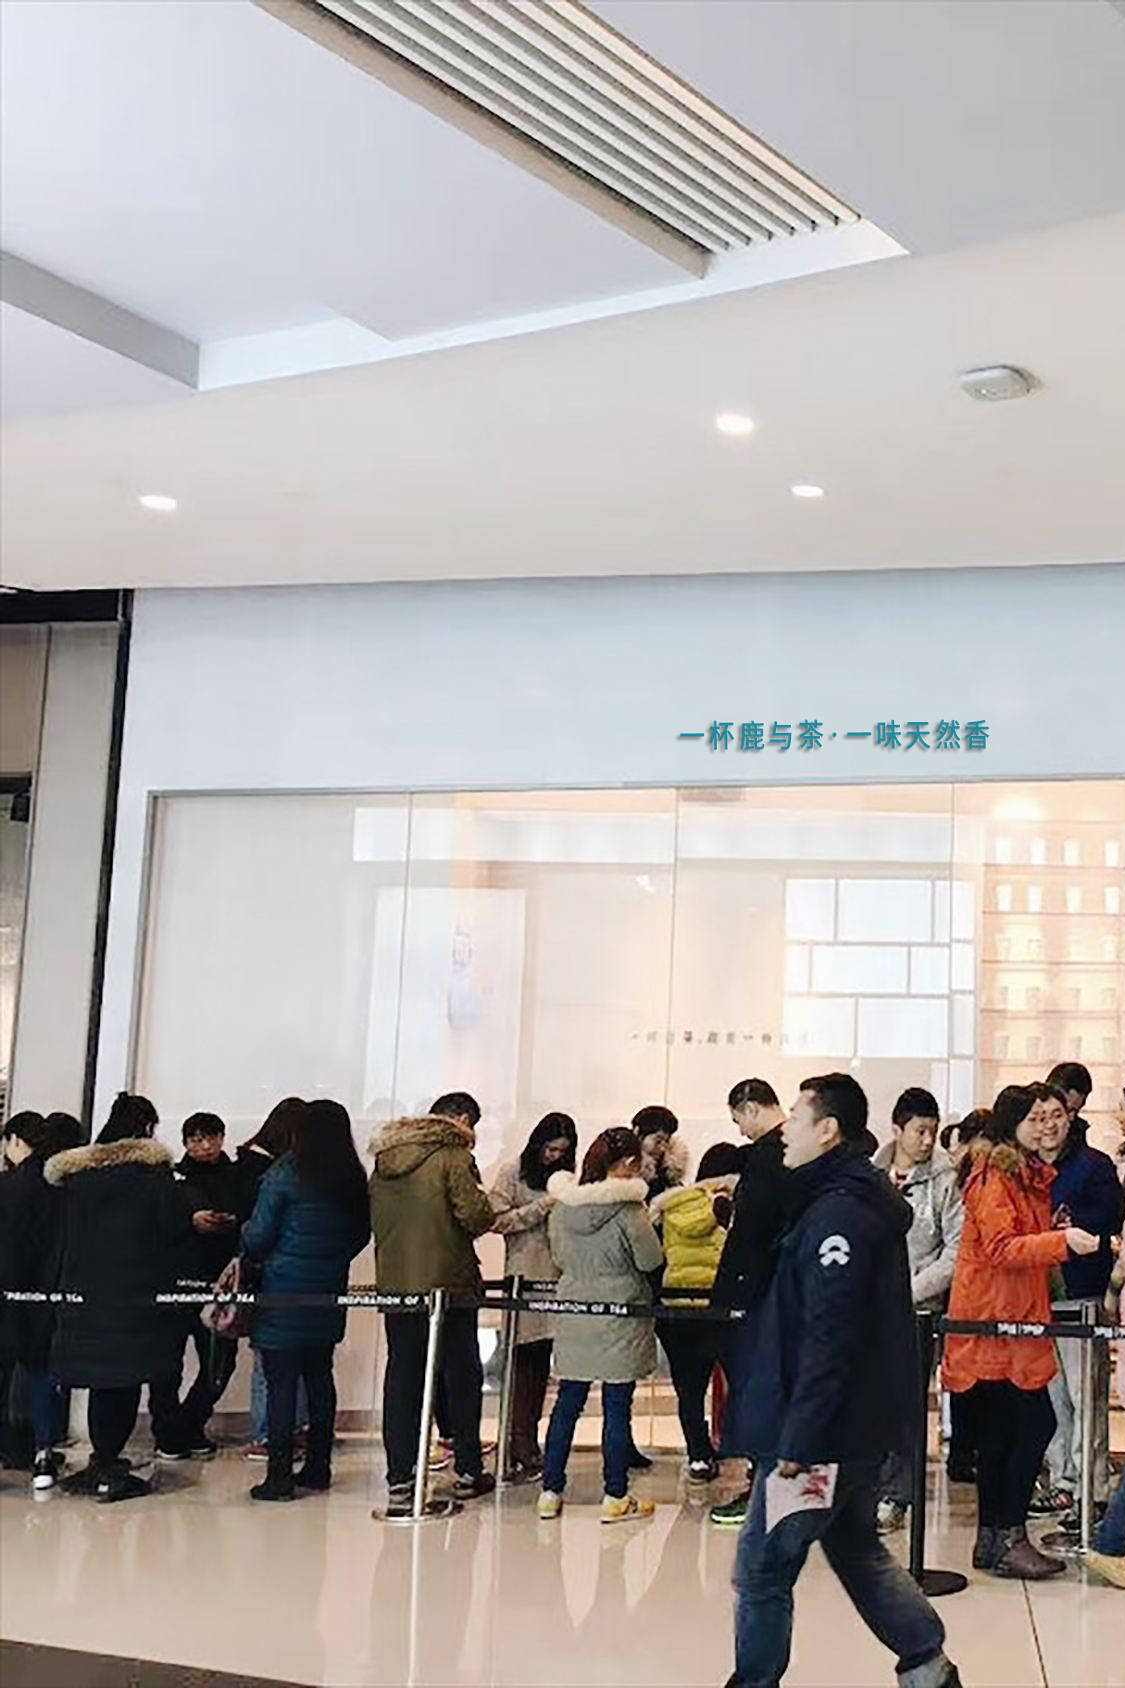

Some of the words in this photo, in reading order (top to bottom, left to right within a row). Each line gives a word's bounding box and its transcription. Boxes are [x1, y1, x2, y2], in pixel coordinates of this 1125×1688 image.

[679, 719, 991, 751] 一杯鹿与茶·一味天然香
